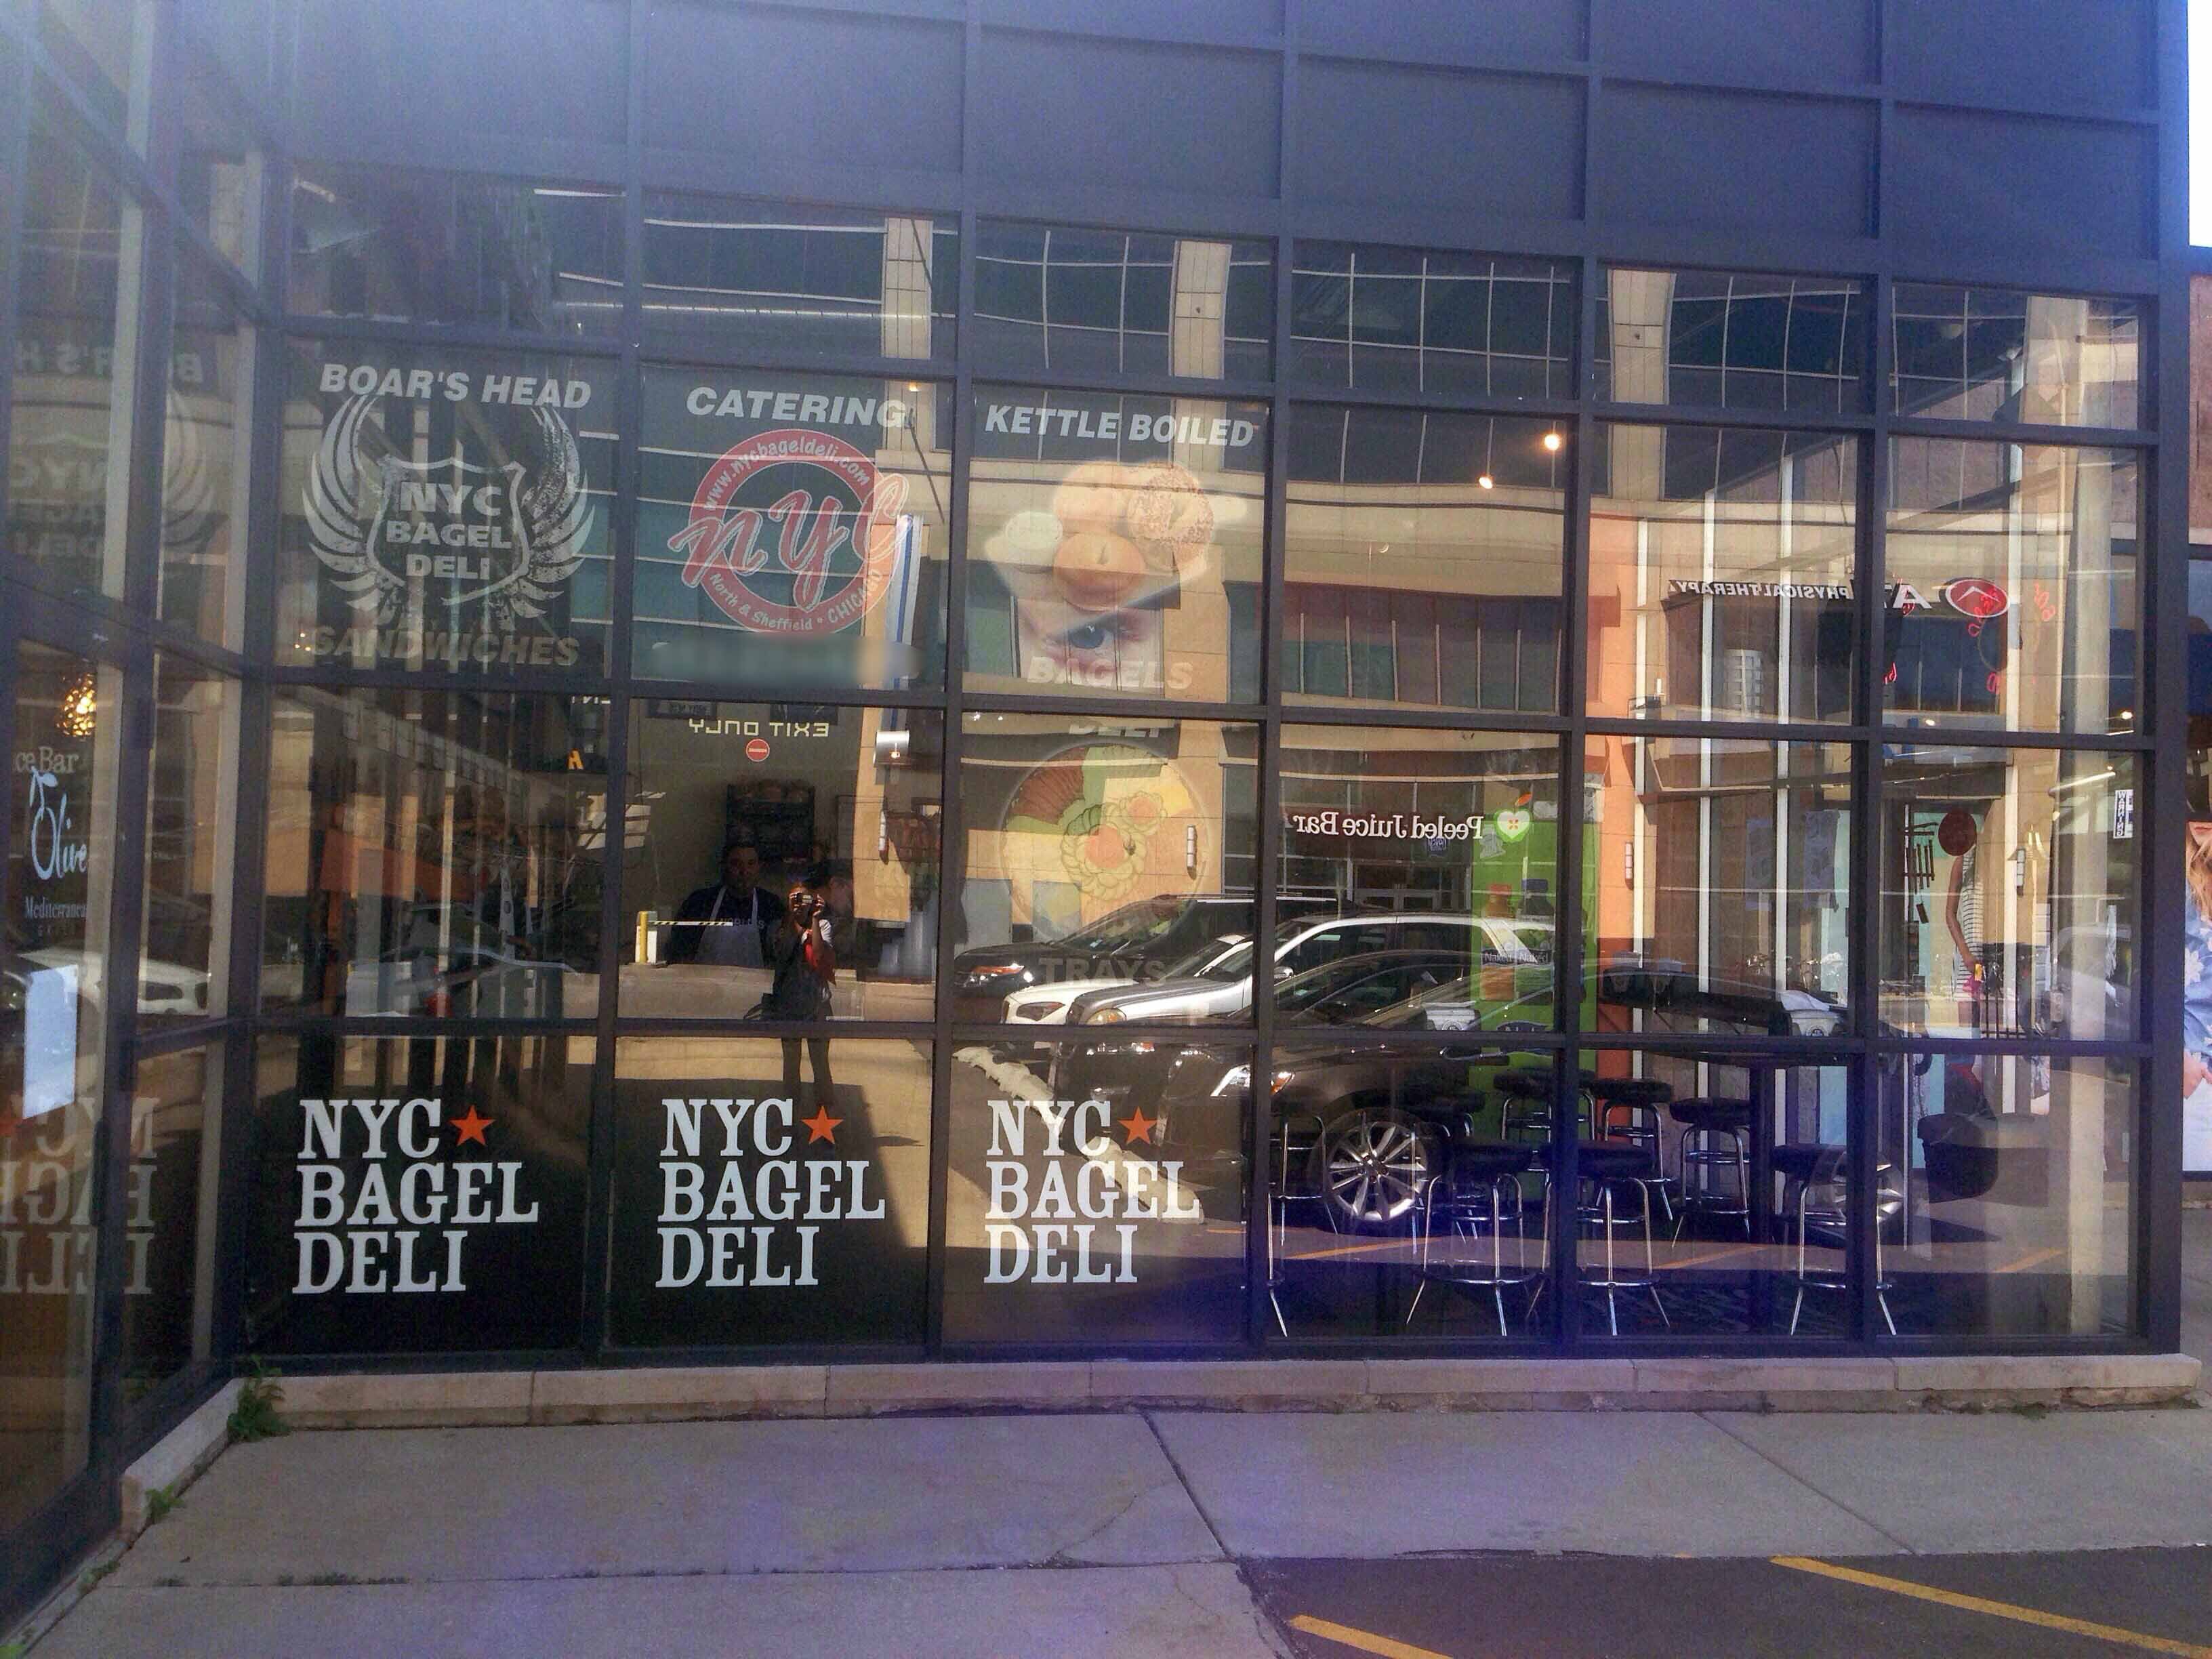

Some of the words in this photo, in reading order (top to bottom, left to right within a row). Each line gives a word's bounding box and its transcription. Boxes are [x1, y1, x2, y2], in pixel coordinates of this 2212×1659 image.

[319, 364, 470, 401] BOAR'S
[481, 375, 592, 408] HEAD
[687, 387, 906, 428] CATERING
[985, 405, 1120, 439] KETTLE
[1128, 414, 1253, 447] BOILED
[401, 480, 502, 516] NYC
[385, 519, 512, 549] BAGEL
[406, 554, 491, 581] DELI
[710, 573, 739, 608] North
[312, 625, 581, 667] SANDWICHES
[1027, 656, 1193, 690] BAGELS
[39, 746, 79, 774] Bar
[31, 792, 87, 880] Olive
[1038, 957, 1170, 987] TRAYS
[297, 1098, 441, 1160] NYC
[660, 1098, 793, 1157] NYC
[986, 1100, 1111, 1157] NYC
[294, 1162, 539, 1227] BAGEL
[657, 1160, 885, 1223] BAGEL
[985, 1160, 1200, 1219] BAGEL
[291, 1230, 468, 1294] DELI
[655, 1226, 819, 1288] DELI
[983, 1225, 1139, 1284] DELI
